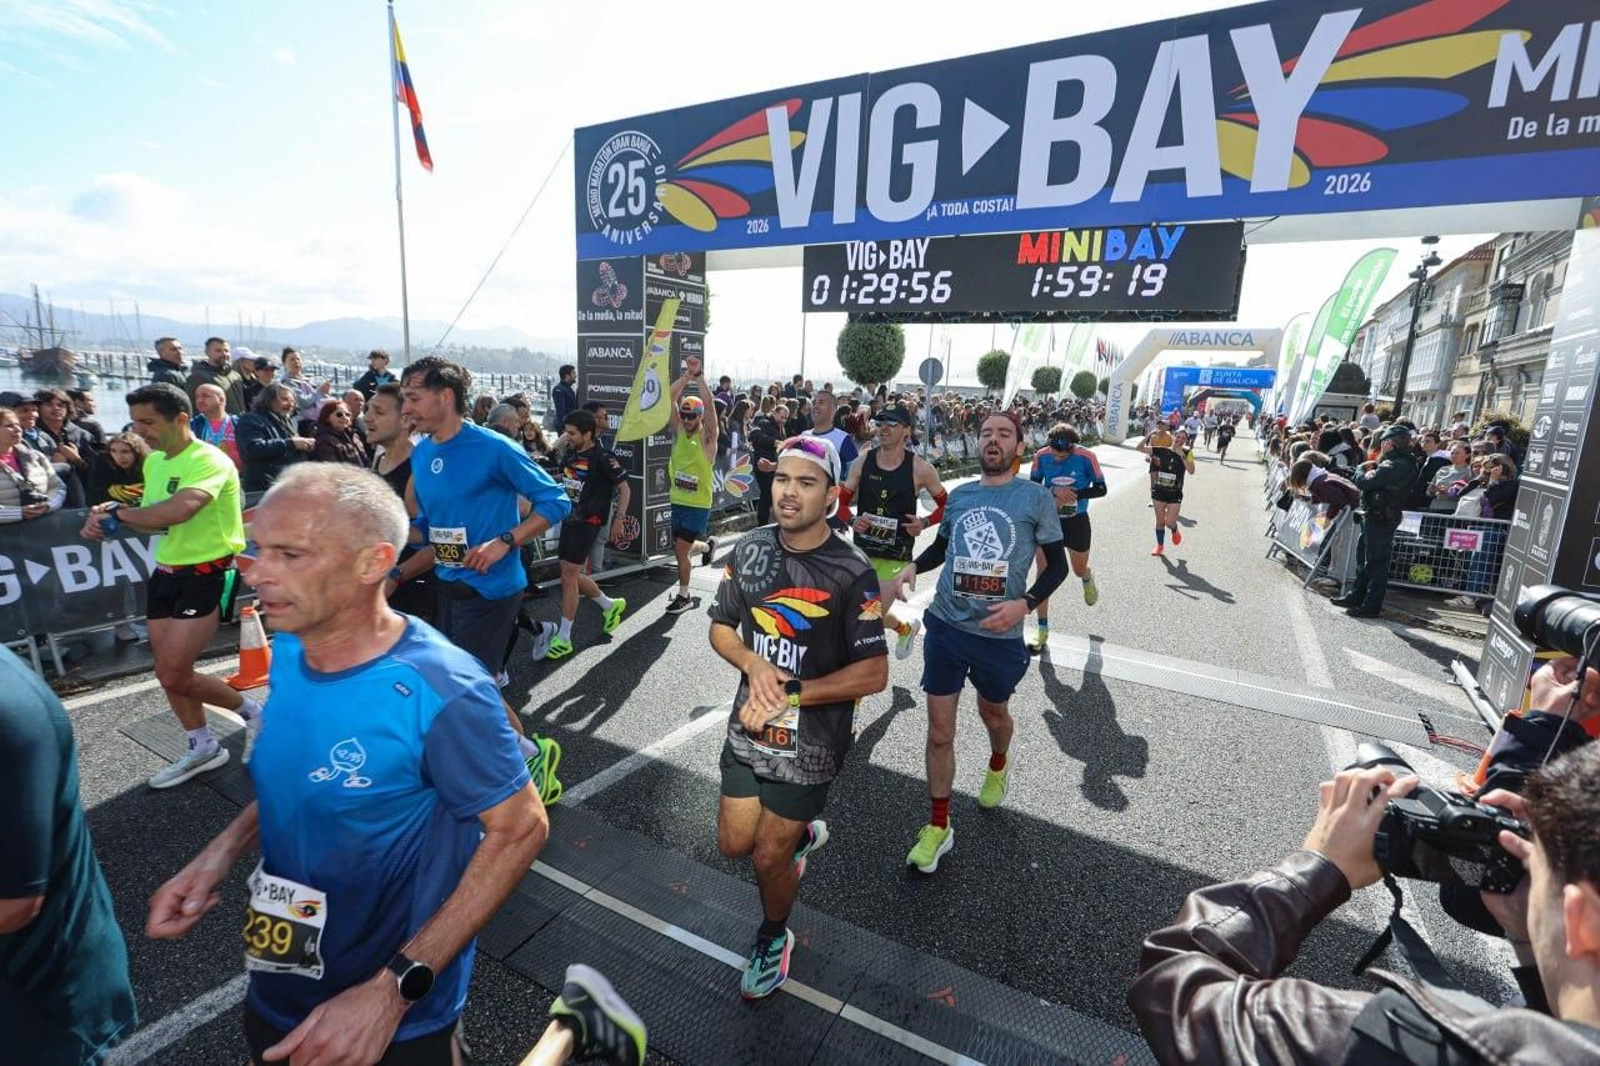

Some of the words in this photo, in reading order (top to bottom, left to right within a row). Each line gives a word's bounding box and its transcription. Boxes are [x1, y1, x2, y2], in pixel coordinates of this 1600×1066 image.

[766, 82, 941, 229] VIG
[1016, 8, 1362, 210] BAY
[1507, 116, 1538, 140] De
[1546, 113, 1570, 136] la
[608, 159, 647, 219] 25
[1324, 172, 1372, 196] 2026
[602, 165, 667, 245] ANIVERSARIO
[926, 203, 938, 221] ¡A
[941, 201, 970, 217] TODA
[973, 197, 1015, 214] COSTA!
[746, 219, 769, 234] 2026
[846, 240, 877, 270] VIG
[889, 238, 931, 270] BAY
[1018, 225, 1186, 265] MINIBAY
[1170, 331, 1255, 346] ABANCA
[588, 347, 633, 358] ABANCA
[1212, 377, 1223, 385] DE
[1213, 370, 1242, 378] XUNTA
[1107, 382, 1123, 436] ABANCA
[51, 530, 160, 594] BAY
[439, 544, 460, 559] 326
[742, 543, 772, 576] 25
[964, 574, 1001, 592] 1158
[269, 883, 296, 905] BAY
